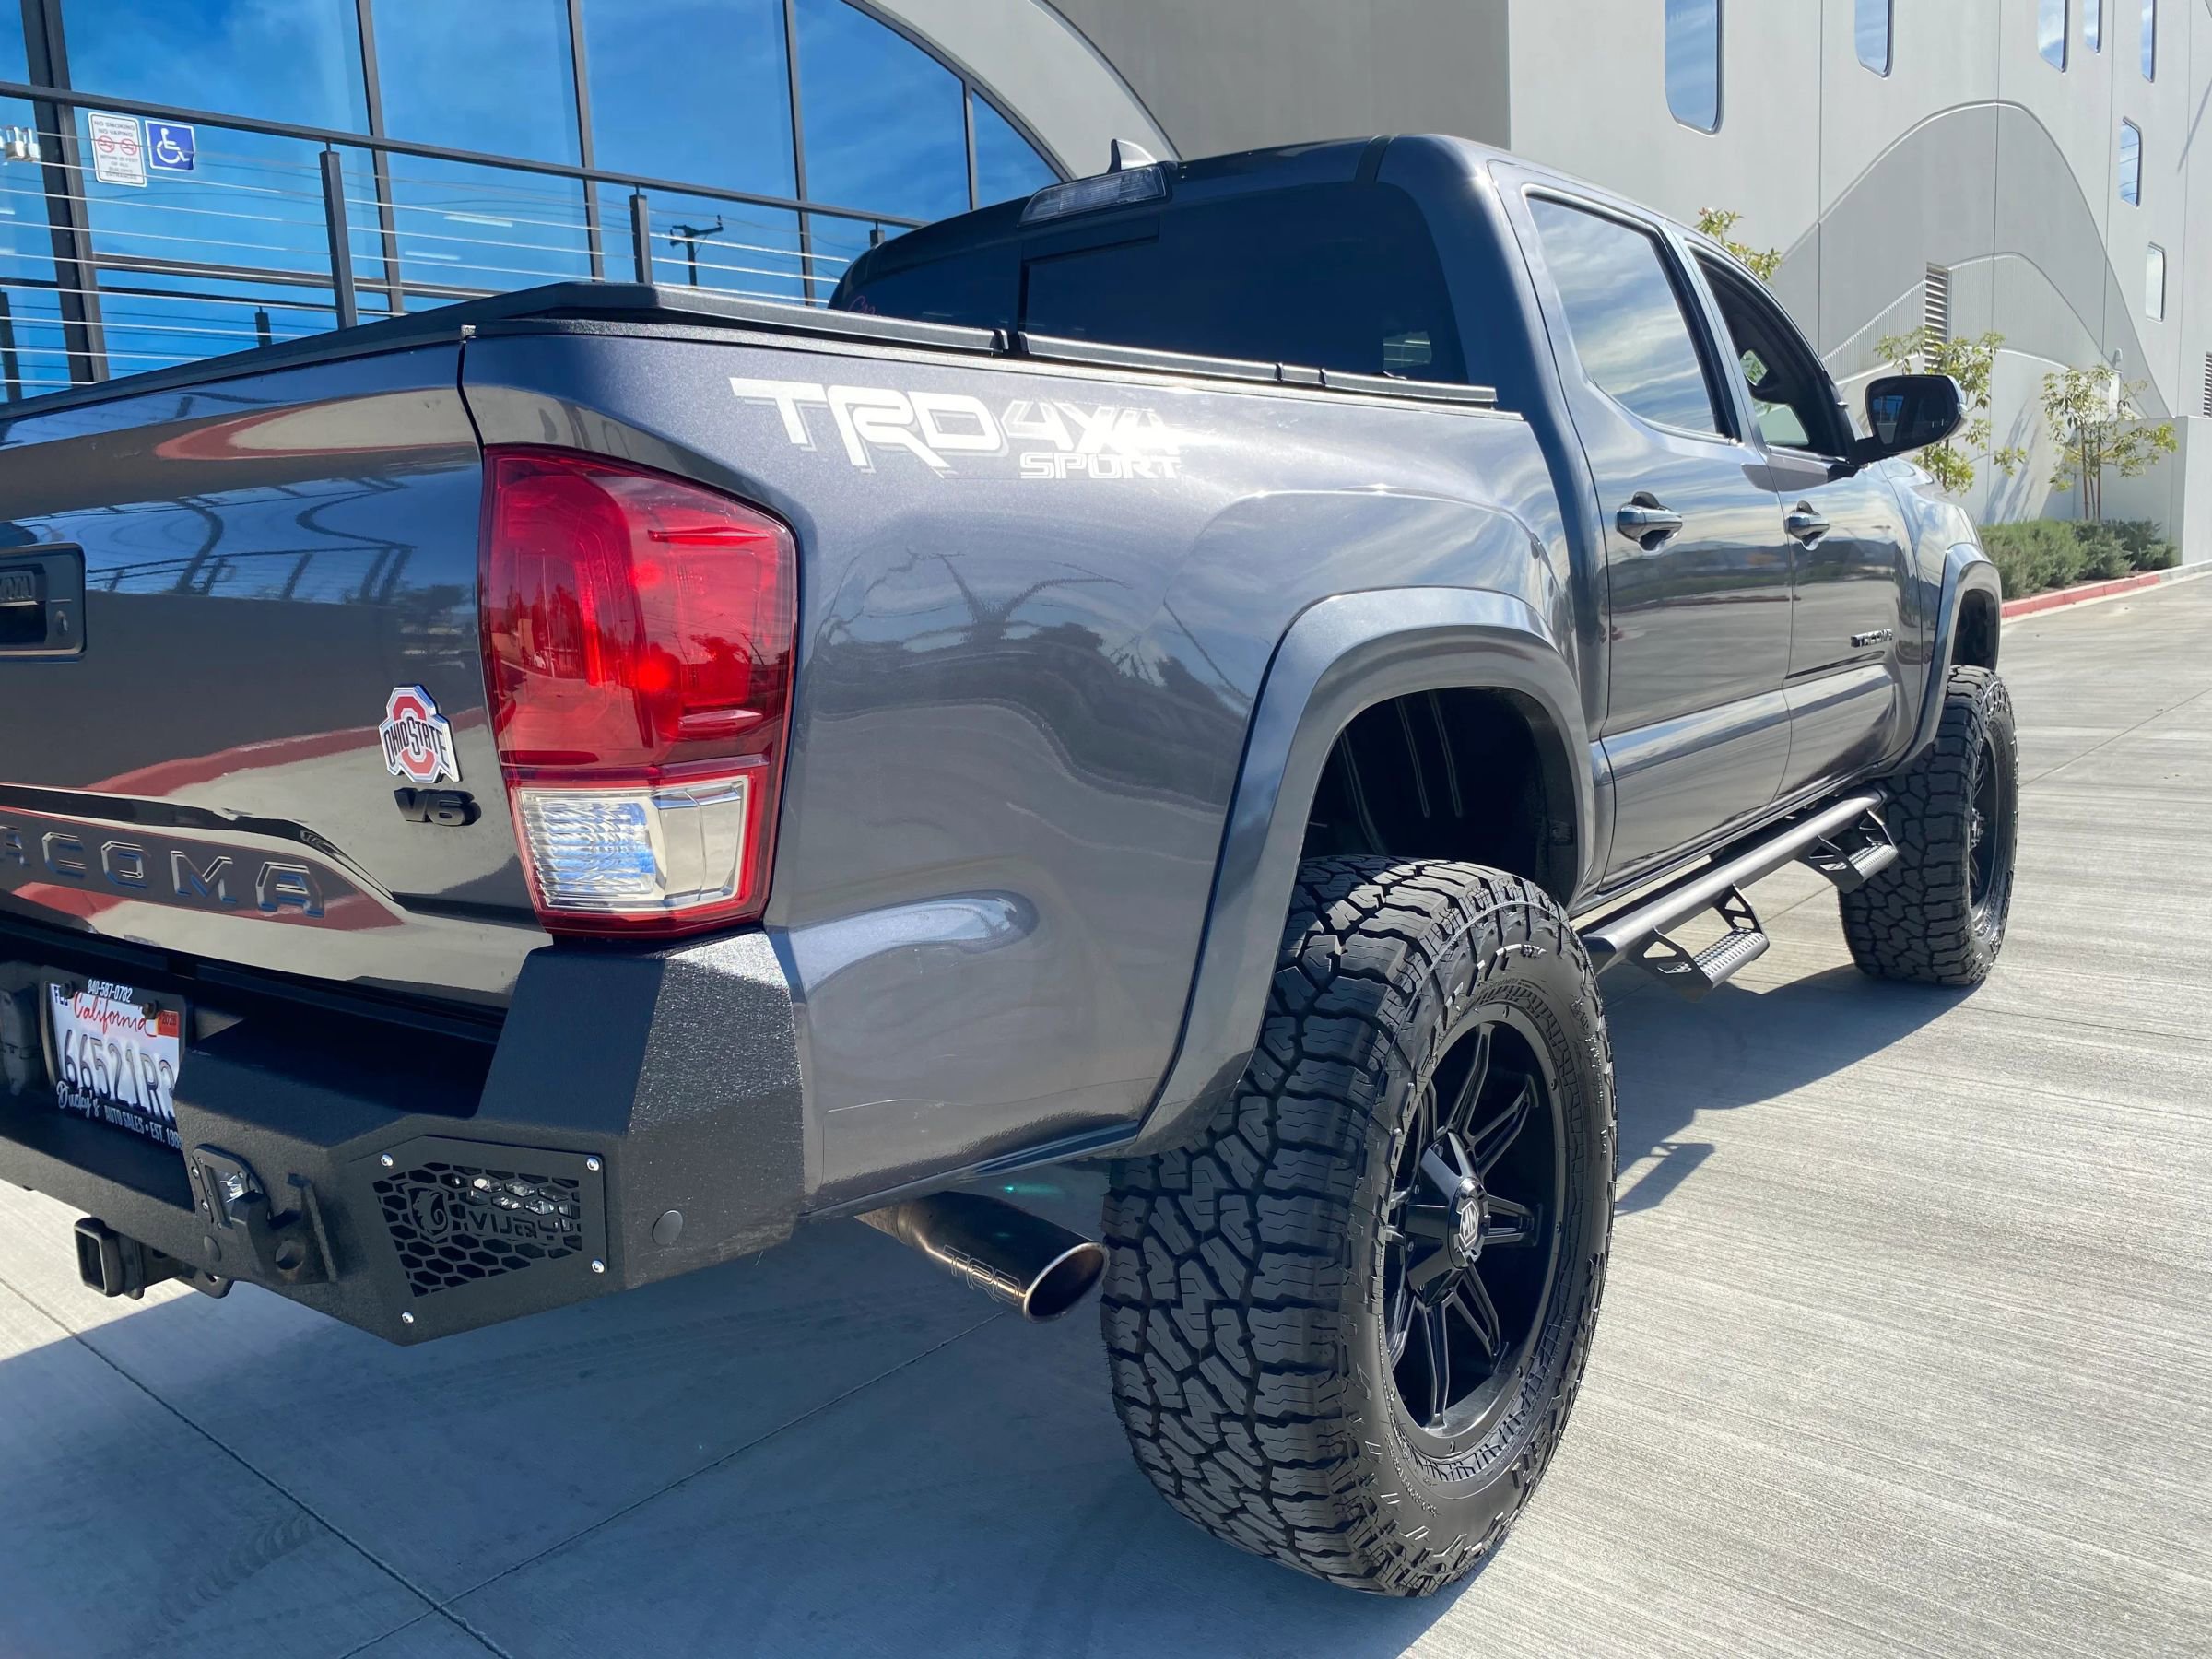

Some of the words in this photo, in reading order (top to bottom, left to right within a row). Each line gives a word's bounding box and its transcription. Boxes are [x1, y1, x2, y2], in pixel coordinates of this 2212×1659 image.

[105, 122, 135, 131] SMOKING
[729, 377, 1009, 479] TRD
[1020, 451, 1181, 479] SPORT
[383, 720, 410, 767] OHIO
[406, 716, 450, 769] STATE
[394, 787, 477, 826] V6
[74, 991, 158, 1037] California
[104, 1105, 123, 1127] AUTO
[122, 1112, 144, 1134] SALES
[150, 1121, 166, 1143] EST.
[943, 1244, 1020, 1306] TRD
